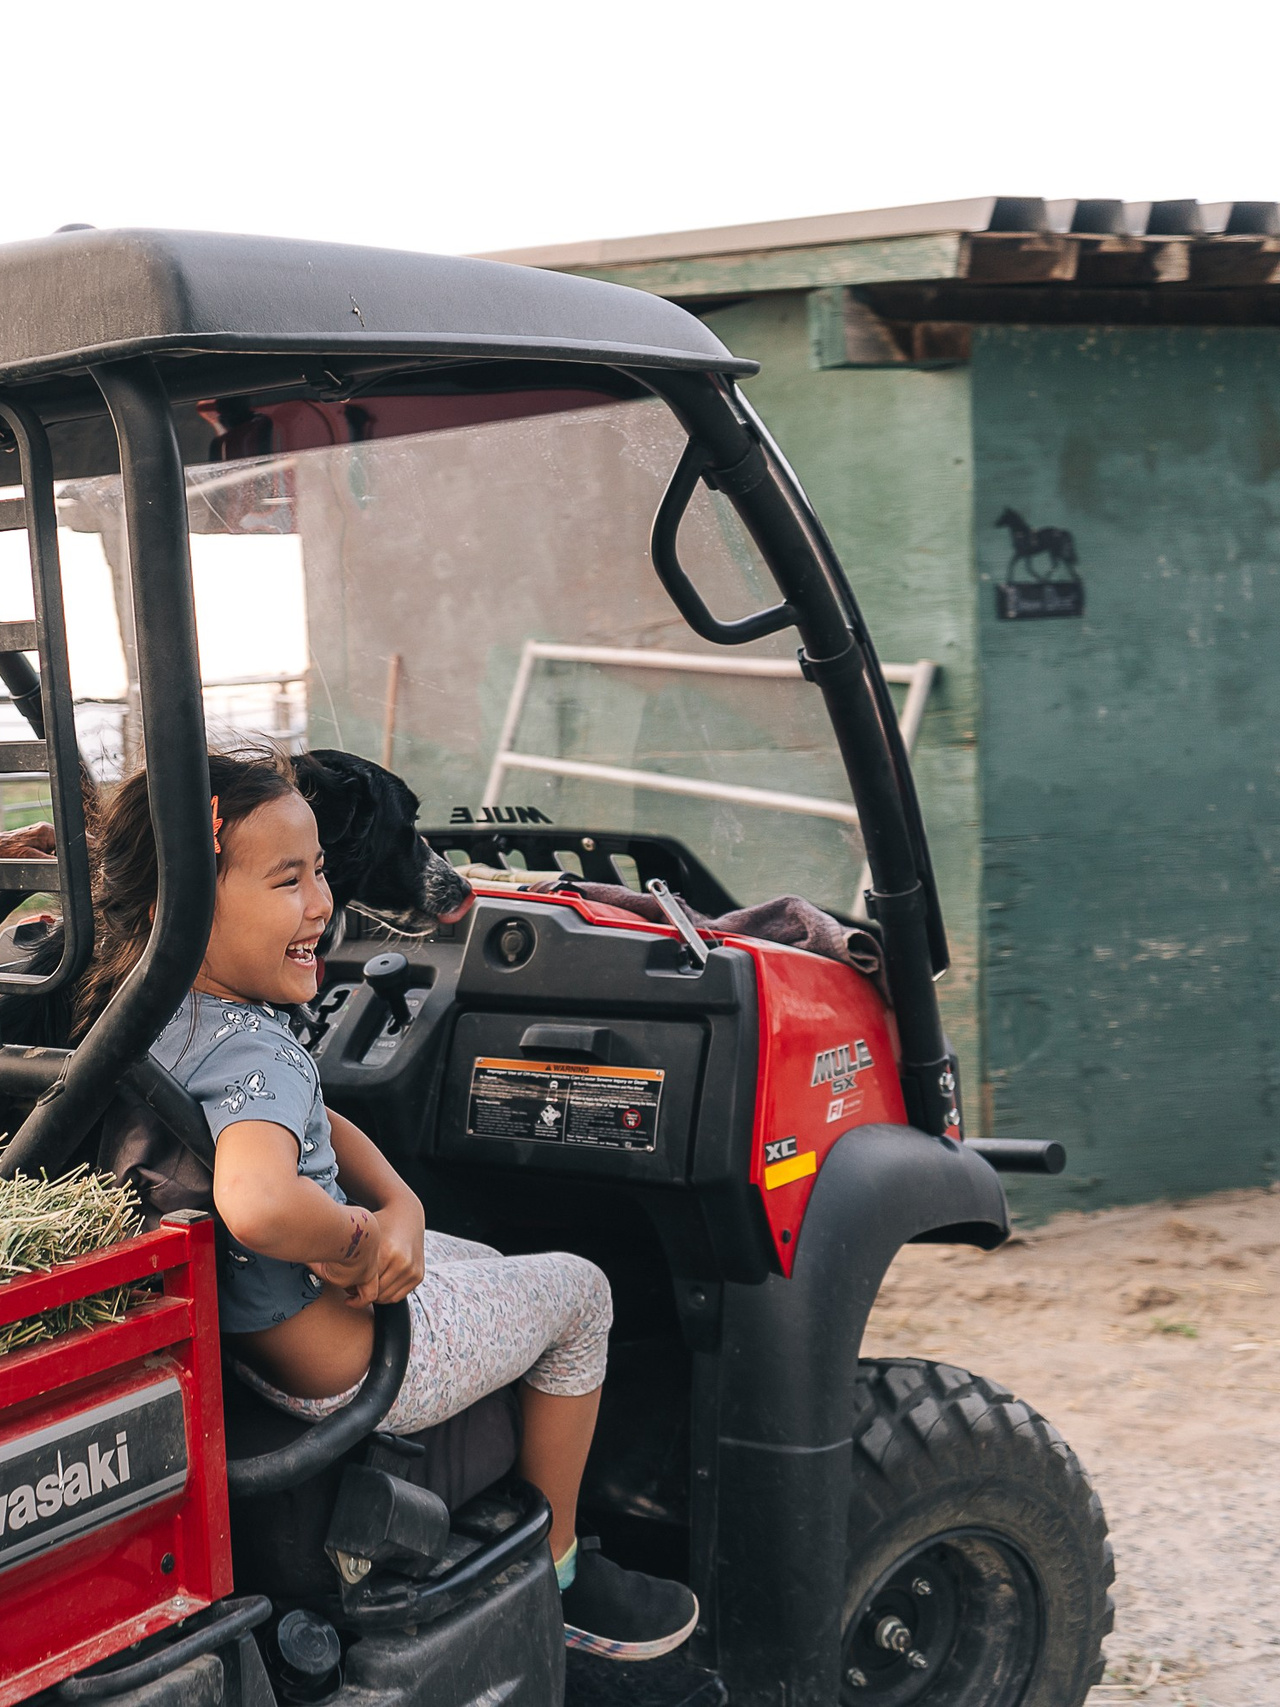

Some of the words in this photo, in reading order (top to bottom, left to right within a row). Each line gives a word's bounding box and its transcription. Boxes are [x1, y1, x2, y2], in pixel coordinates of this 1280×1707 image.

[553, 1065, 589, 1074] WARNING
[811, 1039, 875, 1087] MULE
[832, 1075, 856, 1094] SX
[766, 1138, 797, 1162] XC
